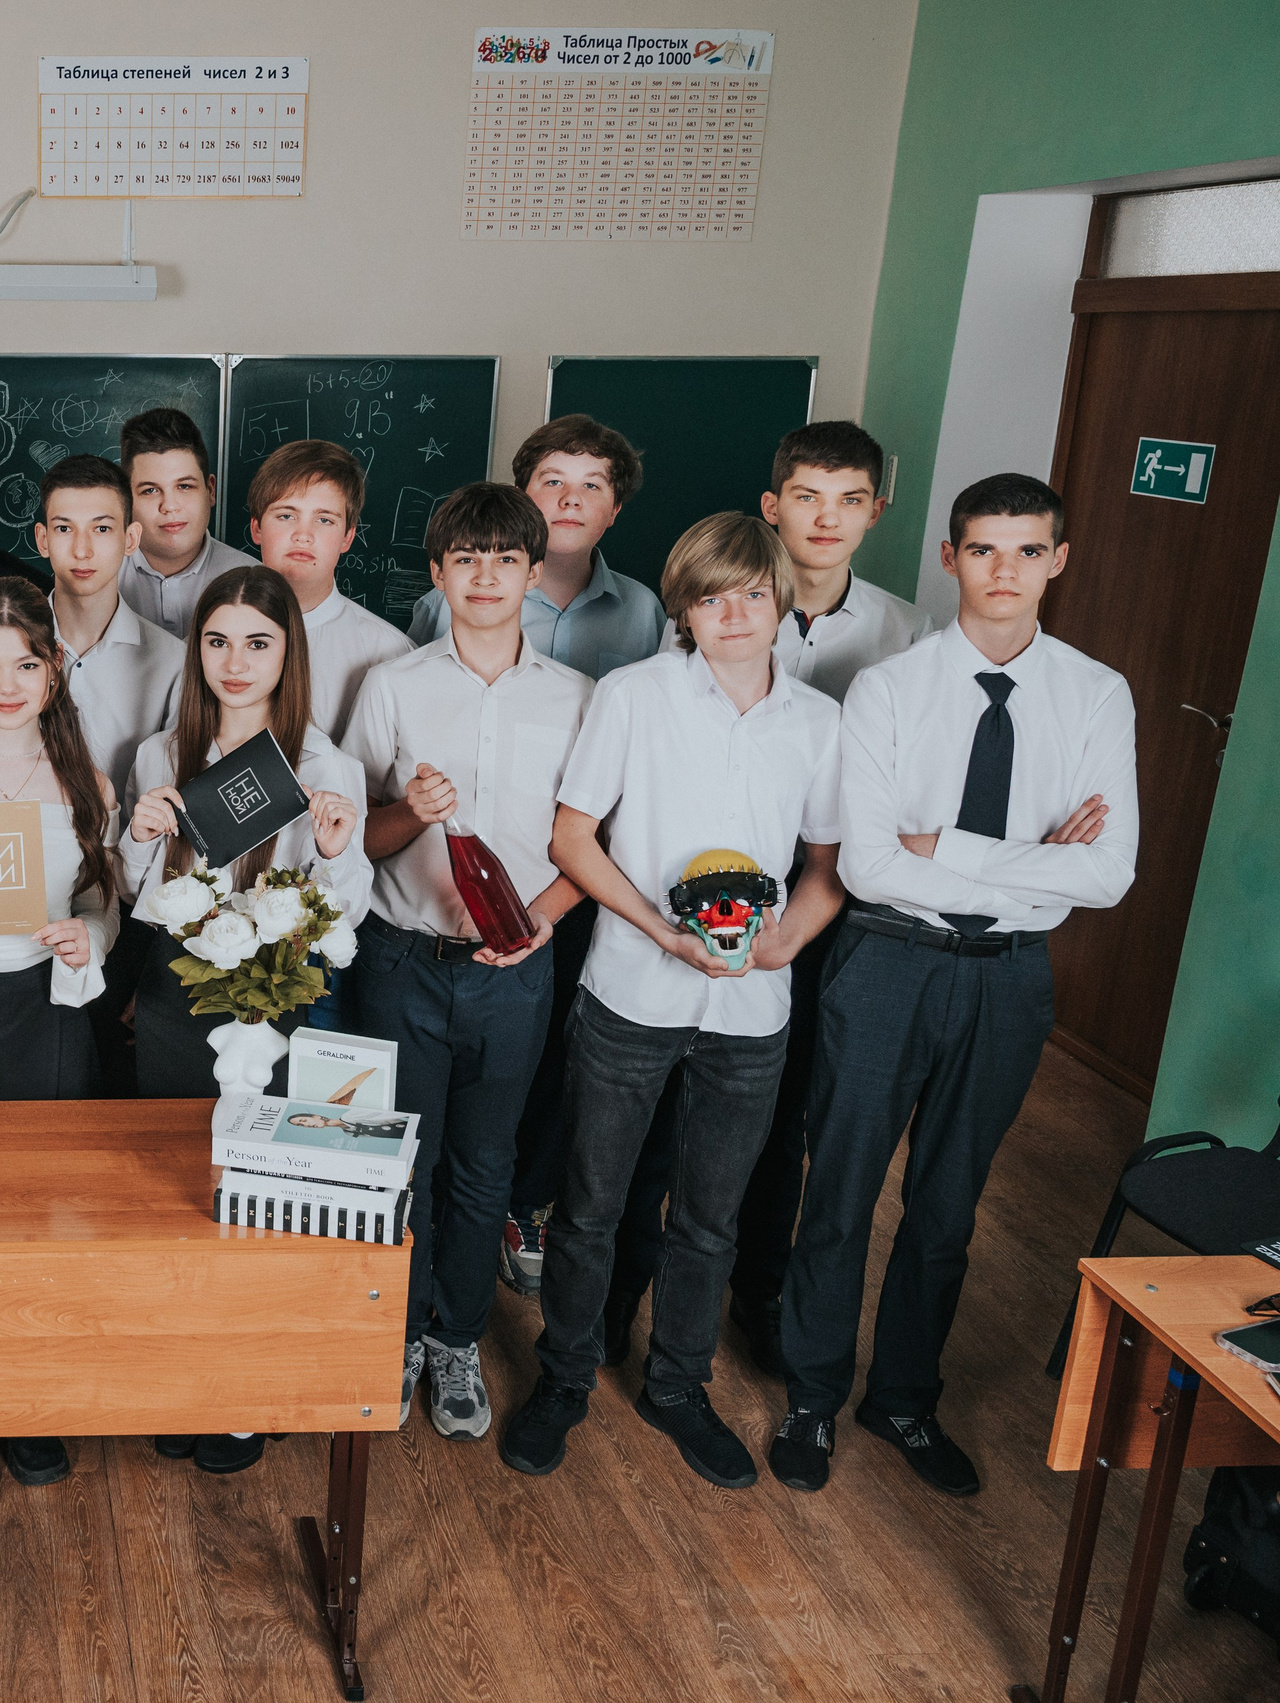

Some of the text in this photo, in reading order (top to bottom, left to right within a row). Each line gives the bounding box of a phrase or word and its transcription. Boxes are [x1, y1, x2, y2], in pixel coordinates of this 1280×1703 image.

[563, 35, 623, 51] Таблица
[628, 35, 688, 52] Простых
[557, 51, 691, 68] Чисел от 2 до 1000
[56, 66, 289, 82] Таблица степеней чисел 2 и 3
[136, 141, 147, 150] 16
[157, 141, 168, 150] 32
[179, 141, 190, 150] 64
[201, 141, 216, 150] 128
[225, 141, 241, 150] 256
[252, 141, 268, 150] 512
[280, 141, 300, 150] 1024
[113, 175, 124, 184] 27
[135, 176, 145, 184] 81
[154, 175, 170, 184] 243
[176, 175, 192, 184] 729
[197, 175, 217, 184] 2187
[221, 175, 241, 184] 6561
[247, 175, 271, 184] 19683
[275, 175, 301, 184] 59049
[226, 787, 249, 815] НОЙ
[235, 777, 261, 809] НЕ
[317, 1050, 355, 1061] GERALDINE
[250, 1105, 281, 1131] TIME
[227, 1149, 267, 1162] Person
[286, 1156, 312, 1168] Year
[366, 1168, 385, 1176] TIME
